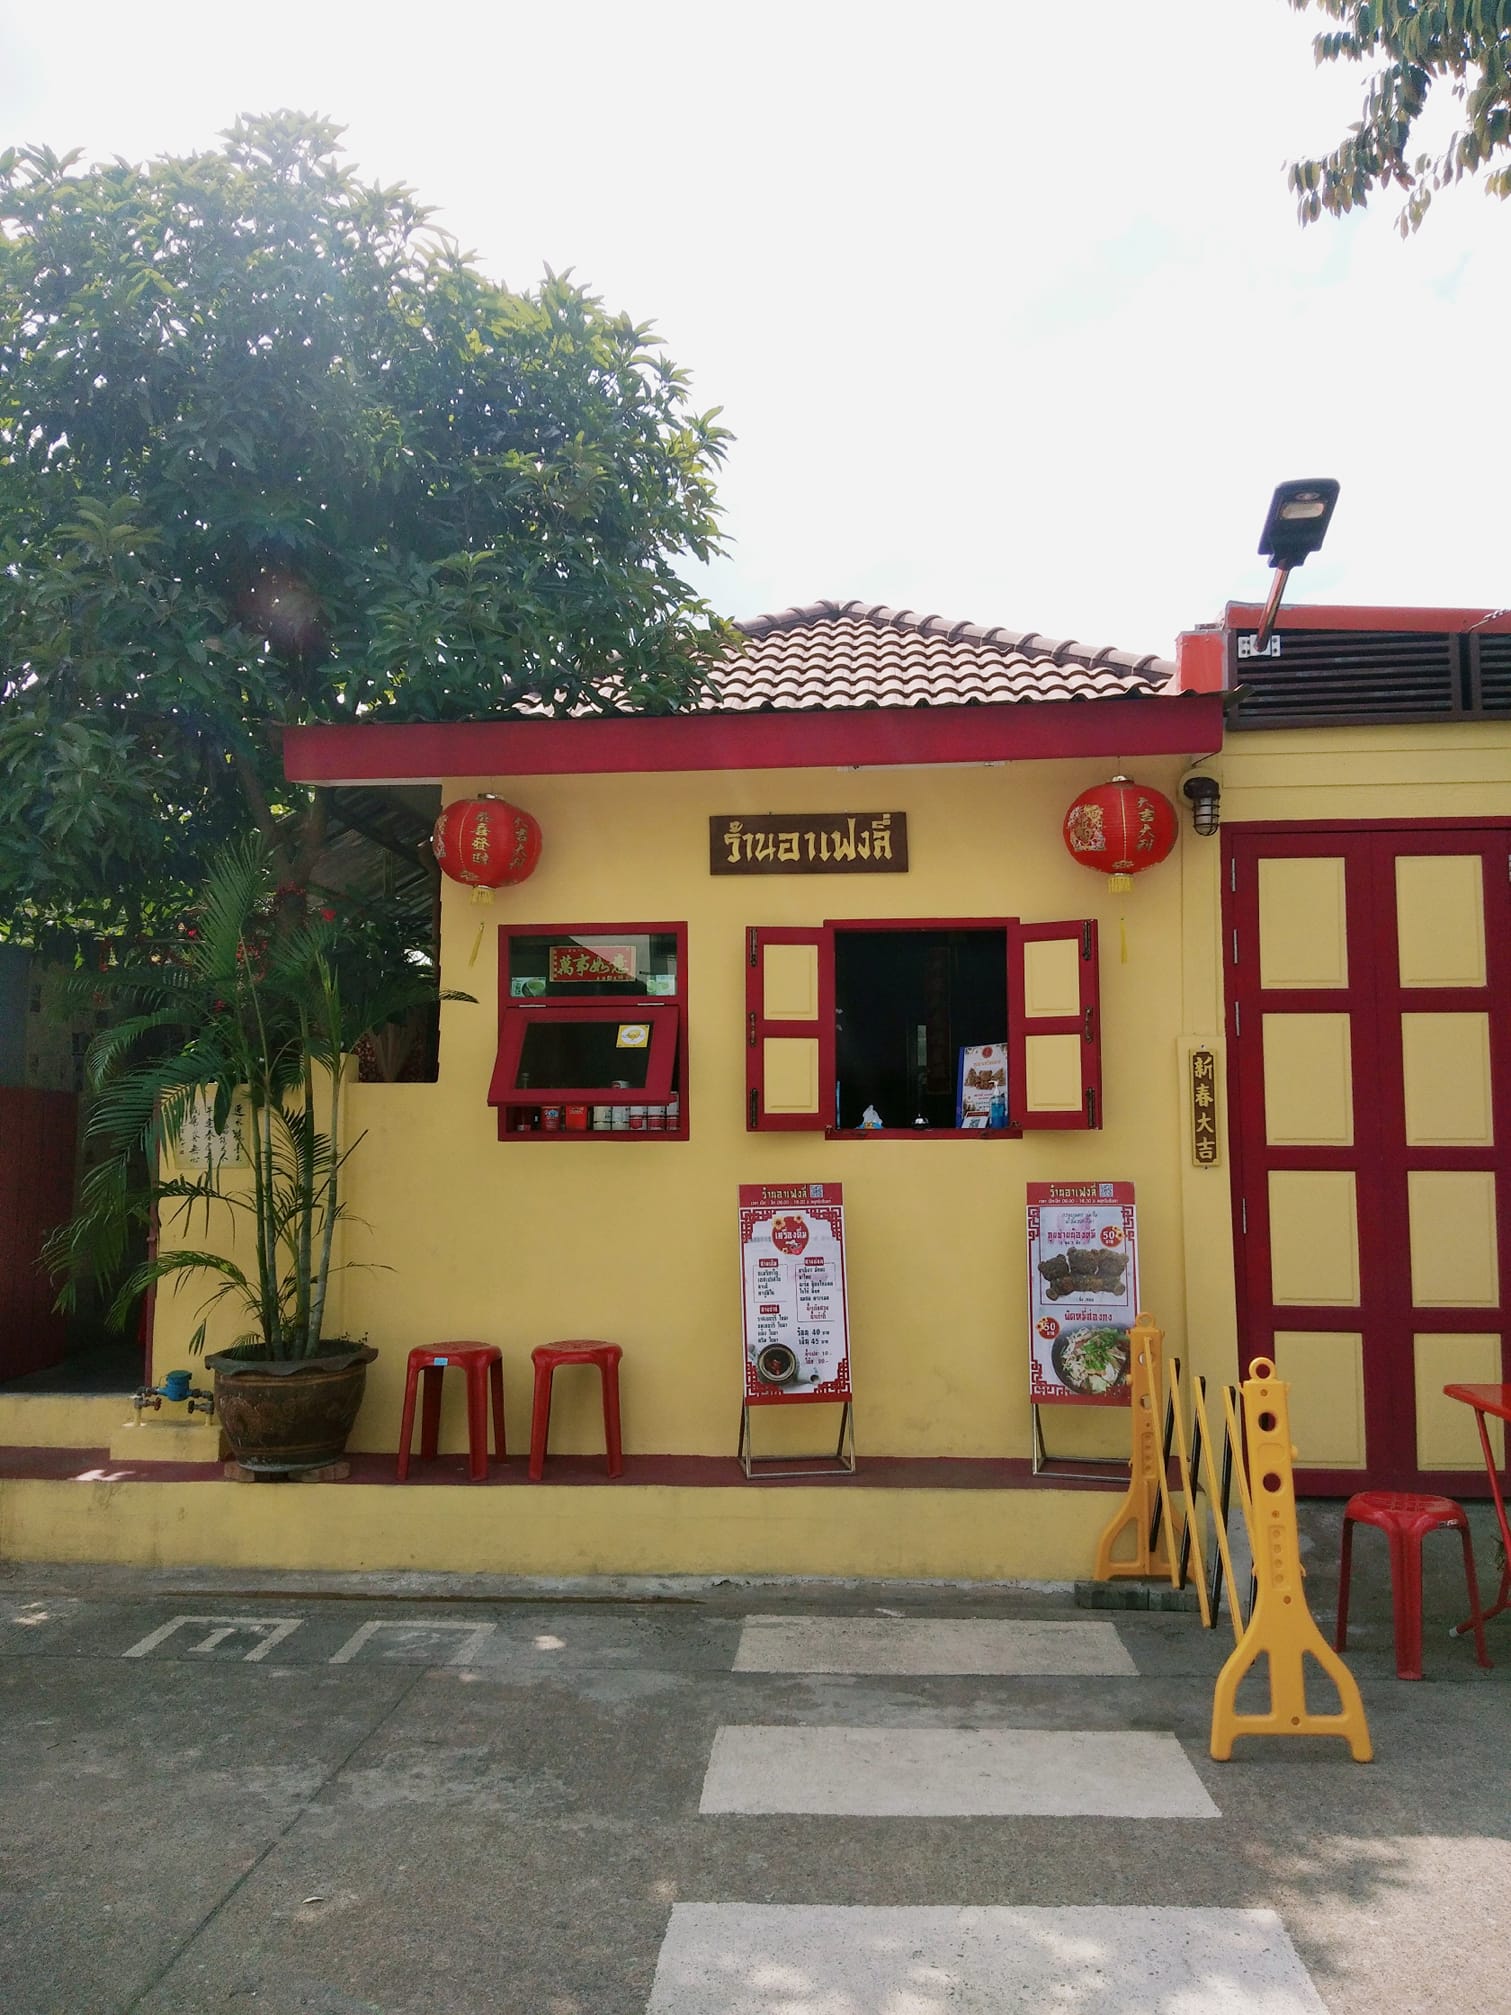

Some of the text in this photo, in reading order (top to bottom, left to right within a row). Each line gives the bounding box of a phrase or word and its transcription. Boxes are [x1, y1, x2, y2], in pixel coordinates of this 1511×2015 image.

[724, 813, 892, 864] ร้านอาเฟงลี่
[1137, 797, 1156, 851] 大吉大利
[1194, 1056, 1215, 1159] 新春大吉
[1103, 1231, 1115, 1240] 50
[1044, 1322, 1056, 1331] 50
